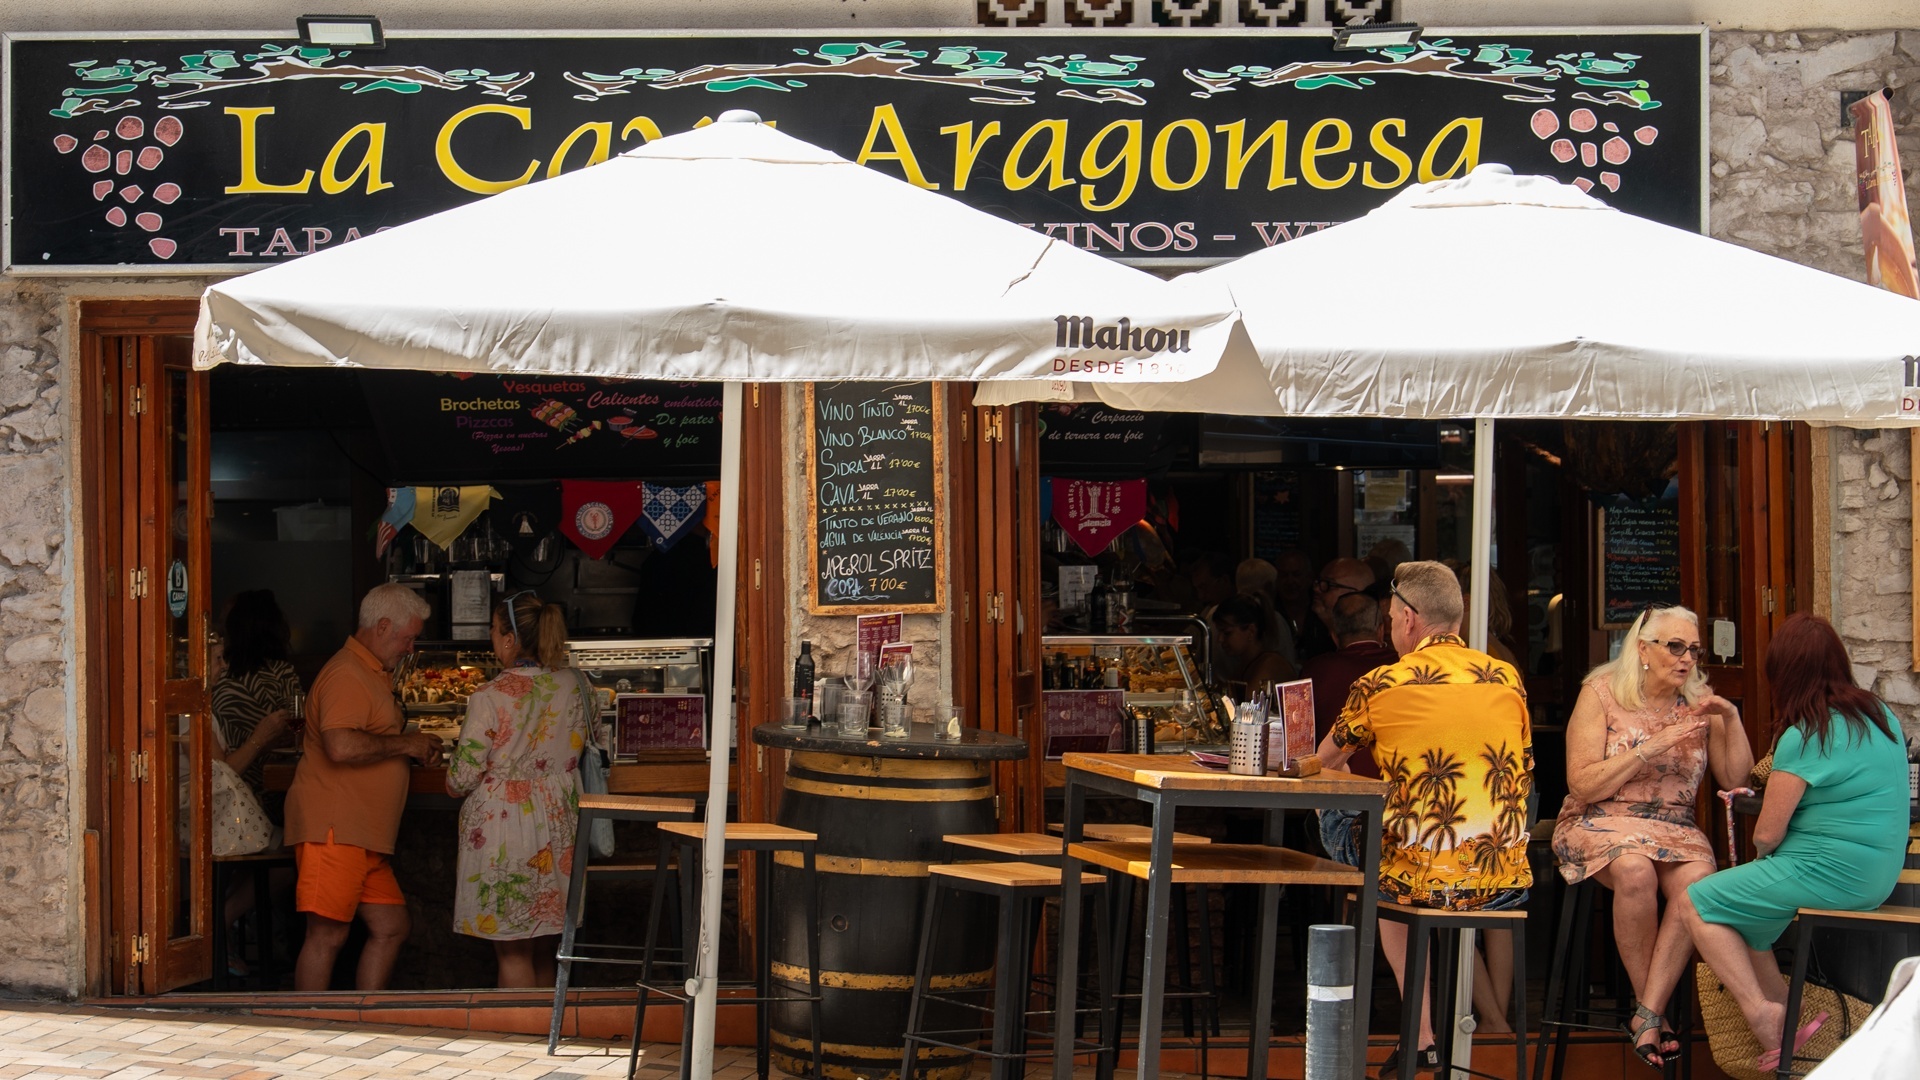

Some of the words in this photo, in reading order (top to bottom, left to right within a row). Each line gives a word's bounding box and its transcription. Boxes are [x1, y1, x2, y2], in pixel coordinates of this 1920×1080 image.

[224, 105, 395, 195] La
[858, 103, 1484, 213] Aragonesa
[1054, 314, 1191, 354] Mahou
[1053, 359, 1124, 374] DESDE
[502, 380, 586, 395] Yesquetas
[440, 397, 521, 411] Brochetas
[586, 390, 661, 409] Calientes
[819, 398, 854, 421] VINO
[1090, 410, 1145, 425] Carpaccio
[455, 415, 514, 429] Pizzcas
[680, 414, 715, 427] pates
[675, 433, 701, 448] foie
[819, 426, 854, 447] VINO
[857, 426, 907, 447] BLANCO
[1048, 430, 1061, 440] de
[1064, 431, 1101, 440] ternera
[1123, 429, 1144, 443] foie
[888, 458, 921, 469] 17'00€
[820, 481, 860, 506] CAVA
[819, 514, 858, 531] TINTO
[861, 517, 875, 526] DE
[820, 531, 847, 549] AGUA
[852, 533, 864, 543] DE
[867, 530, 903, 542] VALENCIA
[821, 553, 877, 580] APEROL
[827, 577, 864, 597] COPA
